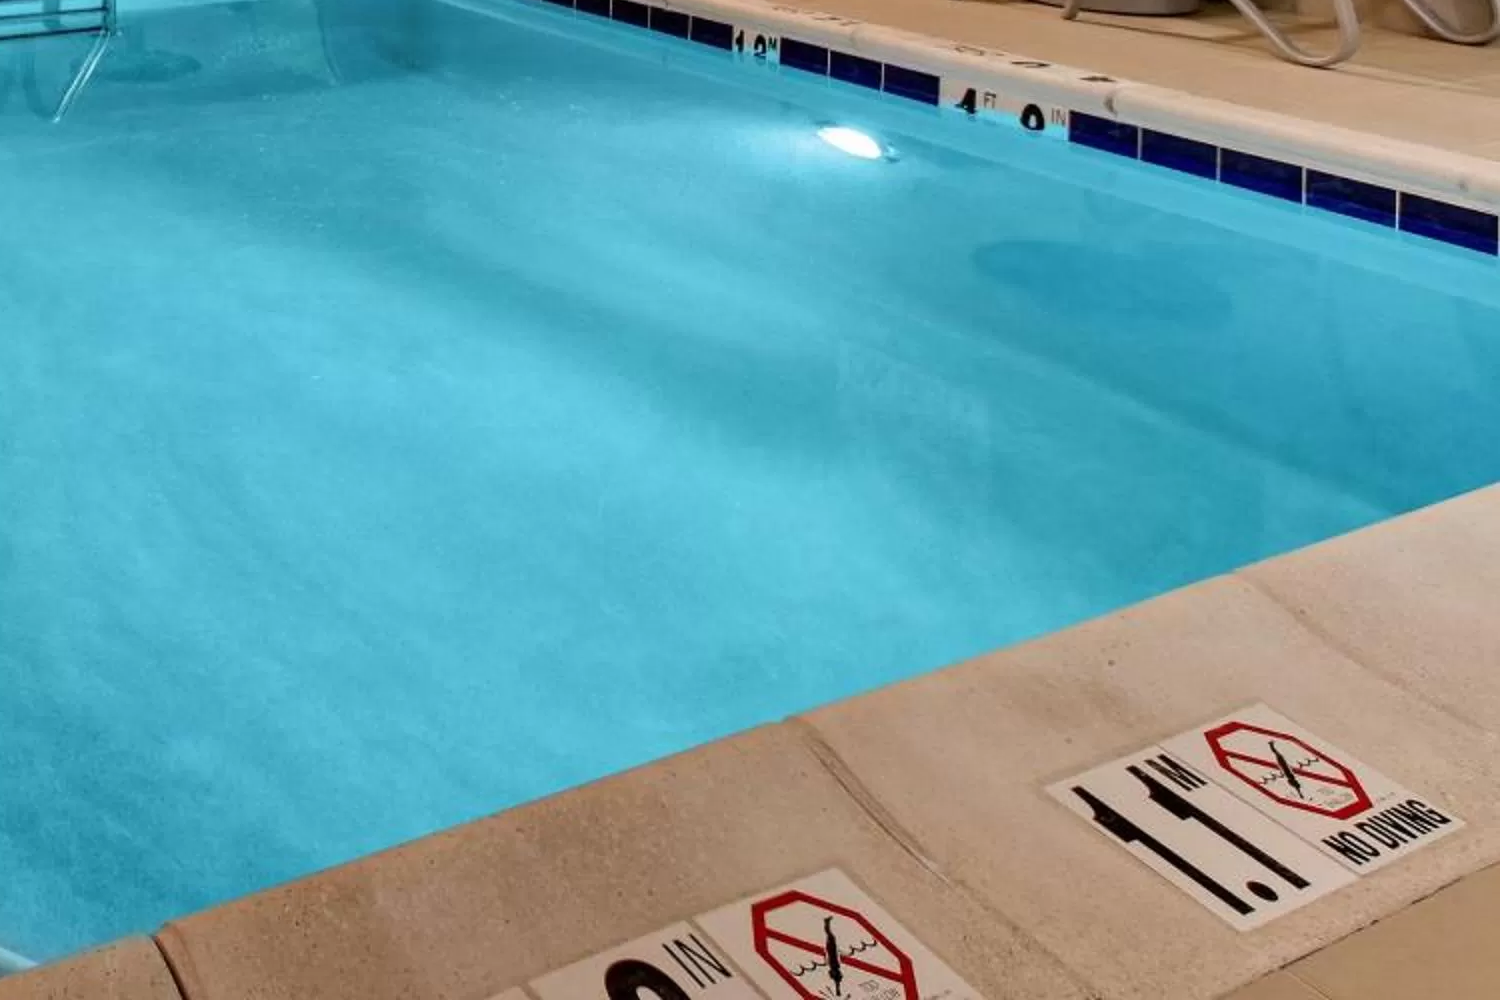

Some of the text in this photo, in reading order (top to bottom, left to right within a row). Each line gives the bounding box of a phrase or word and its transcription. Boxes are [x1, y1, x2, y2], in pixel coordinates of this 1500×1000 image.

[955, 87, 976, 115] 4
[983, 91, 997, 109] FT
[1051, 107, 1067, 127] IN
[1071, 753, 1311, 916] 1.1 M
[1321, 799, 1452, 865] NO DIVING
[662, 933, 733, 989] IN
